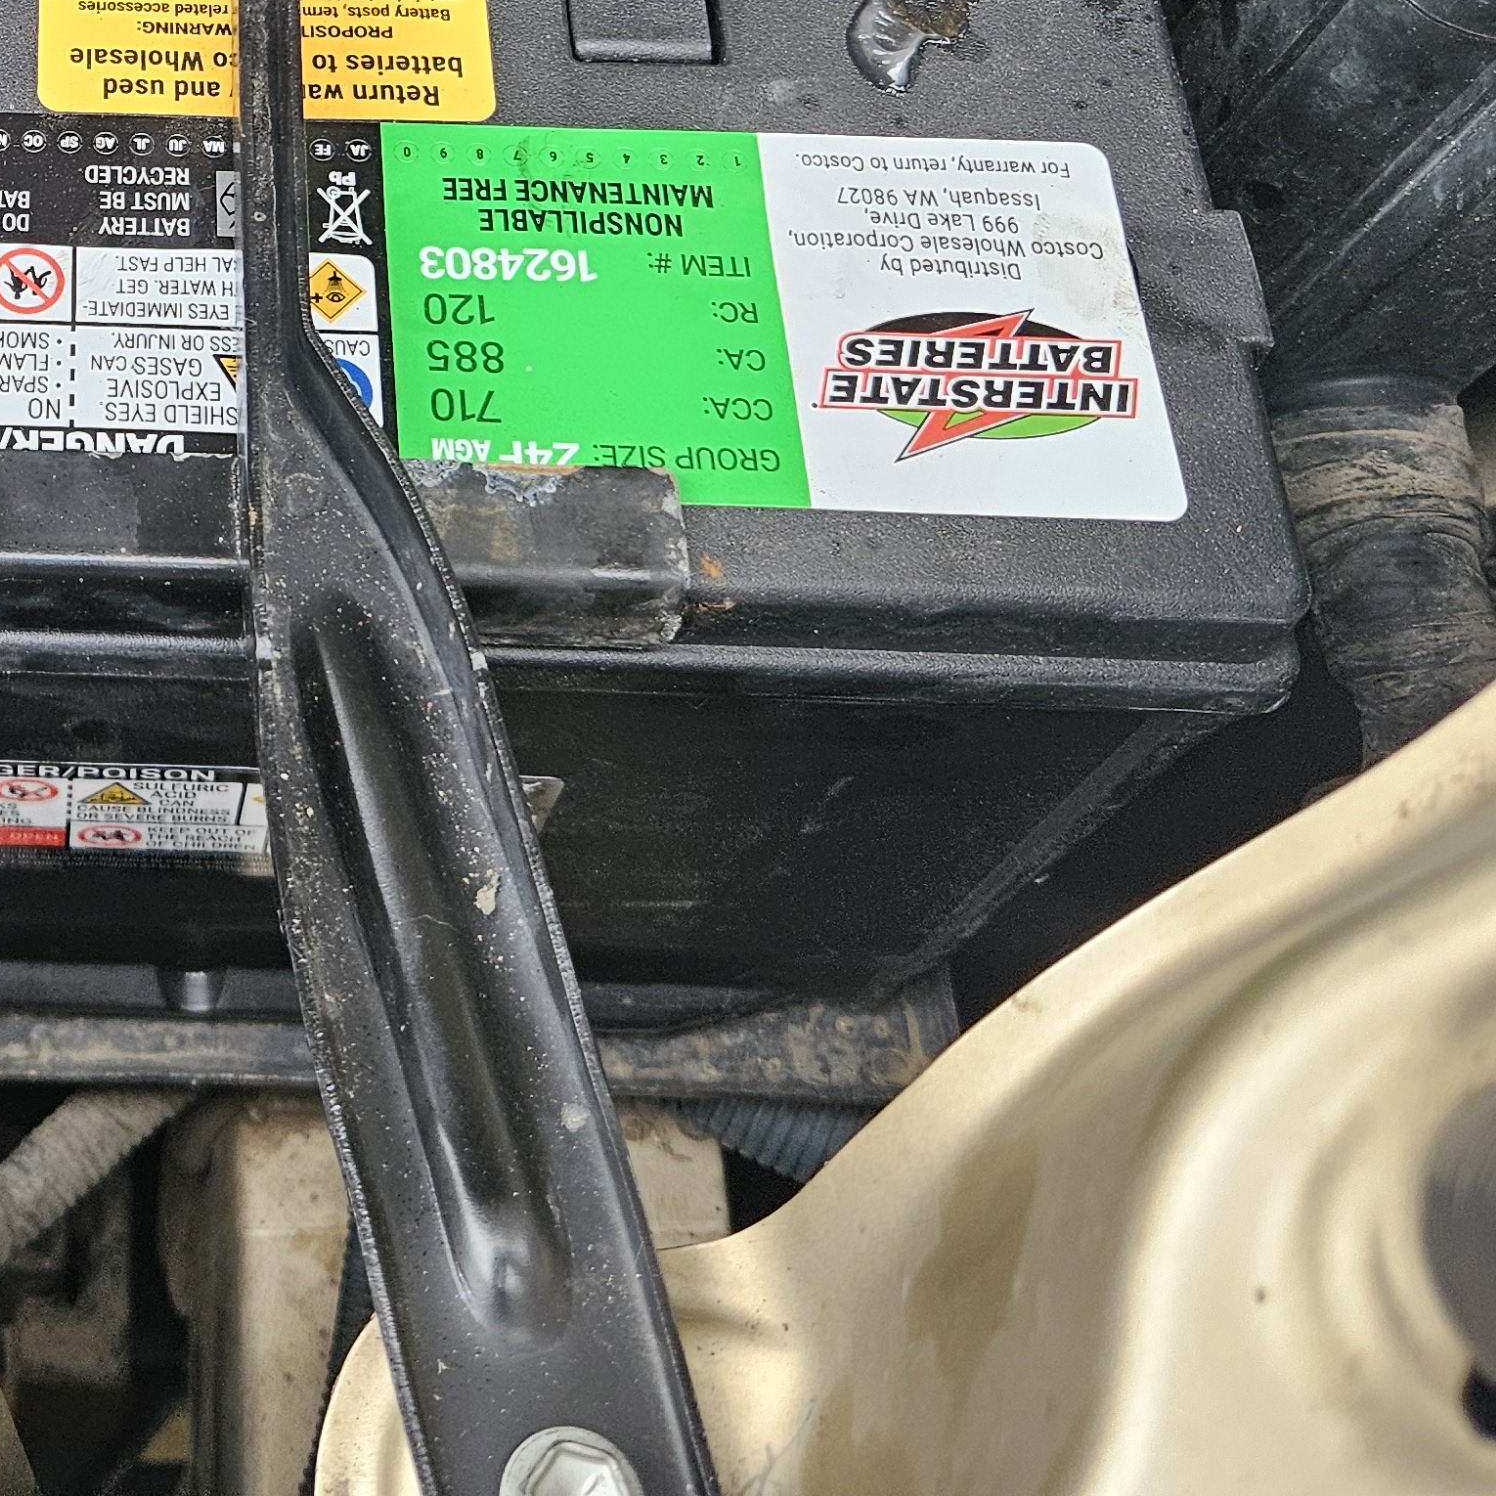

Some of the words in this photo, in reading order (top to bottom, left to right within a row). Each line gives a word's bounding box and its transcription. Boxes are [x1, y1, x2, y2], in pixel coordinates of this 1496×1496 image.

[78, 1, 169, 14] accessories
[175, 4, 228, 17] related
[343, 4, 389, 18] posts,
[395, 5, 450, 21] Battery
[137, 22, 232, 35] WARNING:
[71, 48, 203, 71] Wholesale
[312, 55, 337, 72] to
[346, 55, 462, 77] batteries
[104, 78, 164, 99] used
[175, 80, 220, 101] and
[353, 84, 439, 106] Return
[796, 154, 864, 171] Costco.
[870, 157, 888, 171] to
[893, 158, 946, 172] return
[952, 155, 1035, 173] warranty,
[1041, 162, 1070, 178] For
[85, 165, 190, 185] RECYCLED
[329, 171, 356, 186] Pb
[443, 178, 506, 200] FREE
[515, 180, 713, 208] MAINTENANCE
[838, 187, 898, 205] 98027
[904, 190, 938, 206] WA
[943, 188, 1040, 210] Issaquah,
[100, 191, 125, 209] BE
[131, 192, 189, 210] MUST
[3, 213, 29, 231] DO
[98, 217, 190, 236] BATTERY
[478, 209, 682, 236] NONSPILLABLE
[864, 208, 921, 229] Drive,
[928, 213, 975, 231] Lake
[983, 216, 1018, 233] 999
[788, 230, 913, 252] Corporation,
[921, 236, 1026, 257] Wholesale
[1032, 242, 1103, 259] Costco
[115, 256, 157, 271] FAST.
[164, 257, 206, 272] HELP
[420, 247, 597, 282] 1624803
[648, 253, 672, 273] #:
[682, 254, 750, 277] ITEM
[881, 253, 903, 276] by
[910, 259, 1021, 280] Distributed
[116, 279, 148, 294] GET
[154, 280, 216, 295] WATER.
[82, 301, 182, 318] IMMEDIATE-
[189, 303, 228, 320] EYES
[424, 294, 494, 324] 120
[712, 302, 758, 323] RC:
[111, 333, 175, 349] INJURY.
[182, 335, 204, 351] OR
[91, 355, 126, 371] CAN
[427, 340, 504, 373] 885
[717, 349, 765, 371] CA:
[842, 338, 1112, 373] BATTERIES
[131, 357, 201, 377] GASES
[107, 379, 220, 401] EXPLOSIVE
[827, 375, 1130, 414] INTERSTATE
[28, 398, 60, 419] NO
[99, 402, 155, 422] EYES.
[163, 404, 237, 425] SHIELD
[431, 389, 501, 423] 710
[703, 397, 772, 421] CCA:
[433, 439, 490, 462] AGM
[593, 445, 665, 467] SIZE:
[675, 447, 780, 472] GROUP
